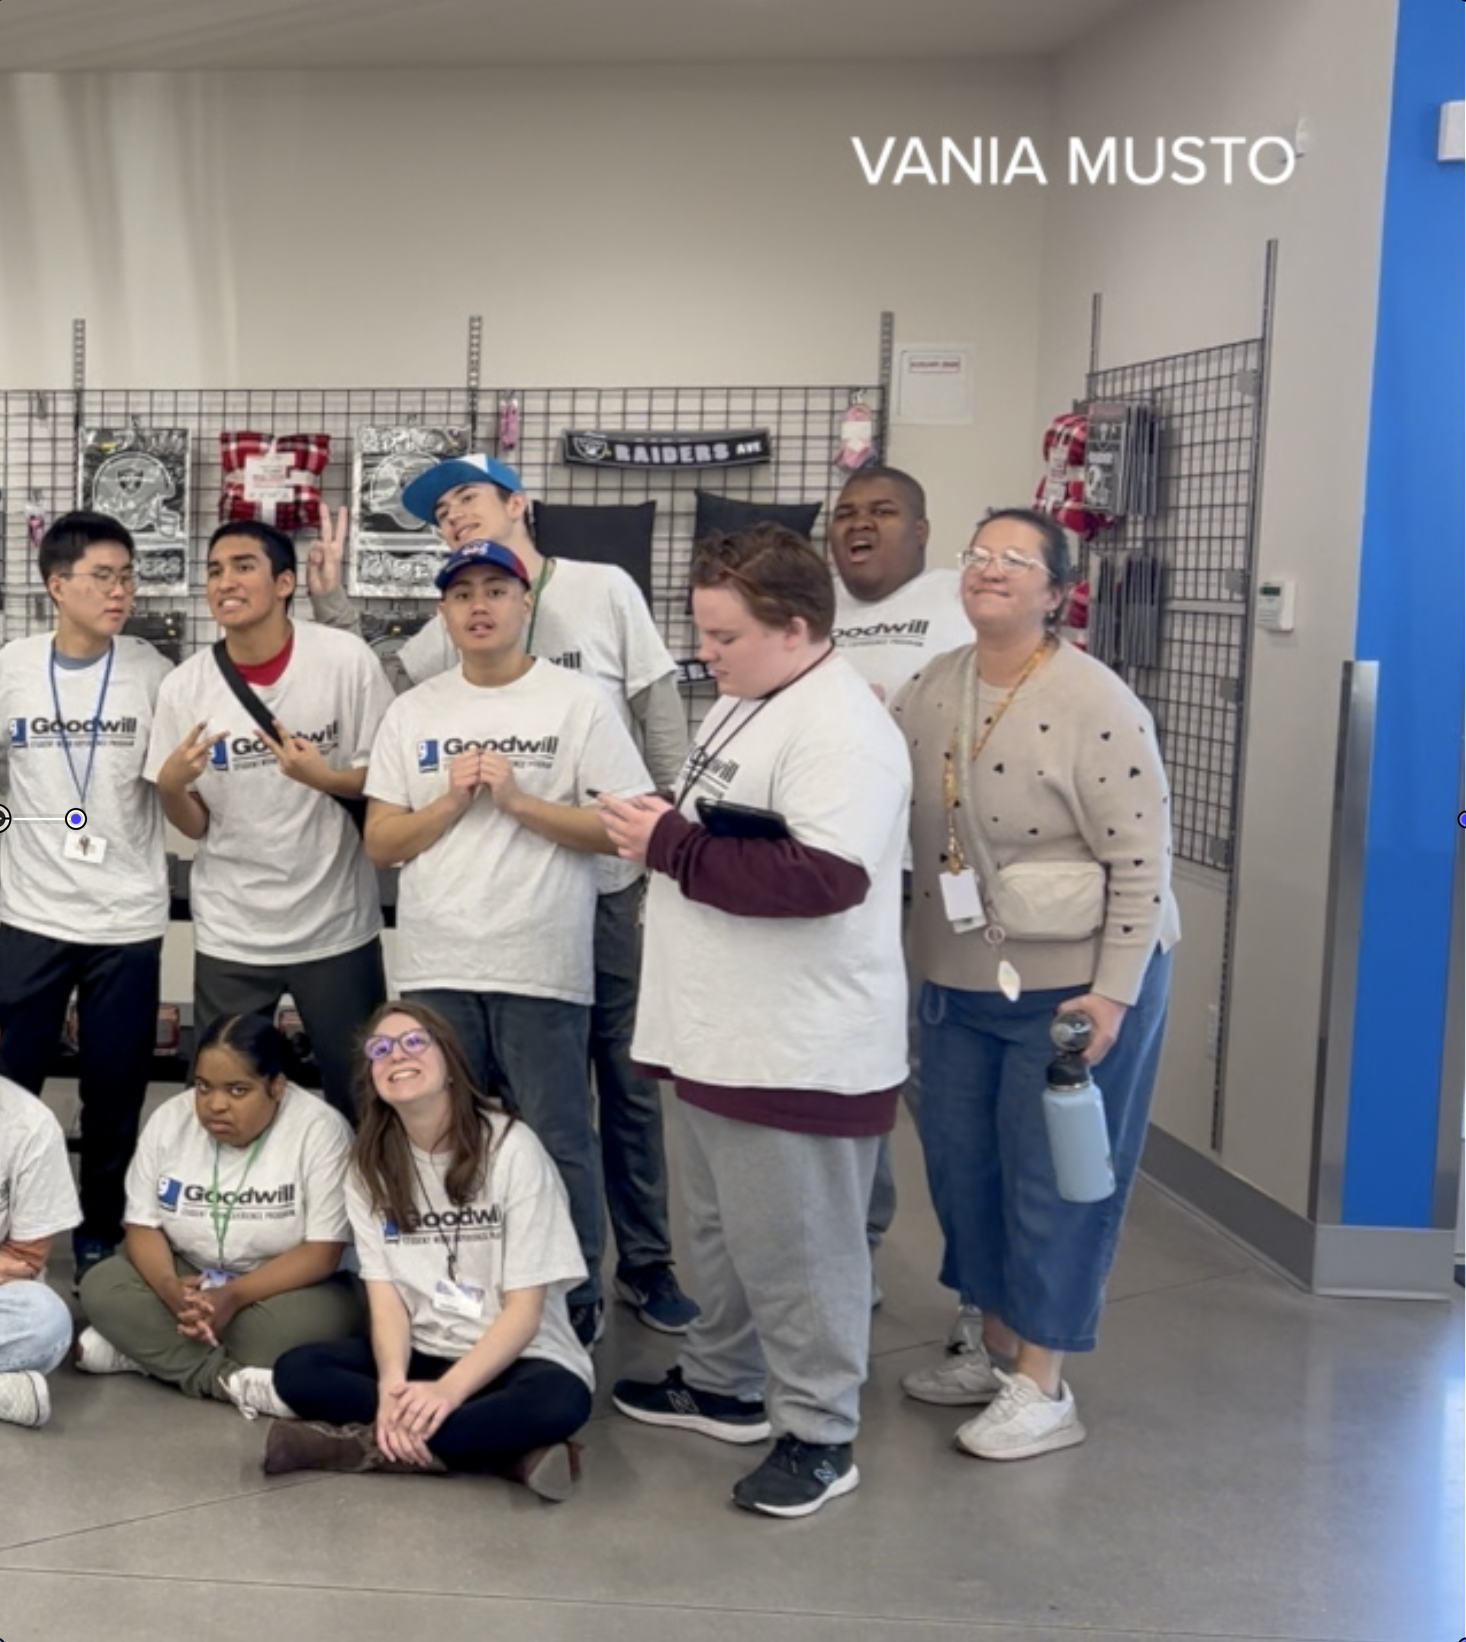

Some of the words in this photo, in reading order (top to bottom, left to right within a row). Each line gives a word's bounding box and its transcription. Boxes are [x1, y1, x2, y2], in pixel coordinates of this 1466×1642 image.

[614, 443, 730, 463] RAIDERS
[736, 441, 761, 455] AVE
[831, 619, 930, 636] oodwill
[30, 715, 138, 735] Goodwill
[183, 1182, 296, 1205] Goodwill
